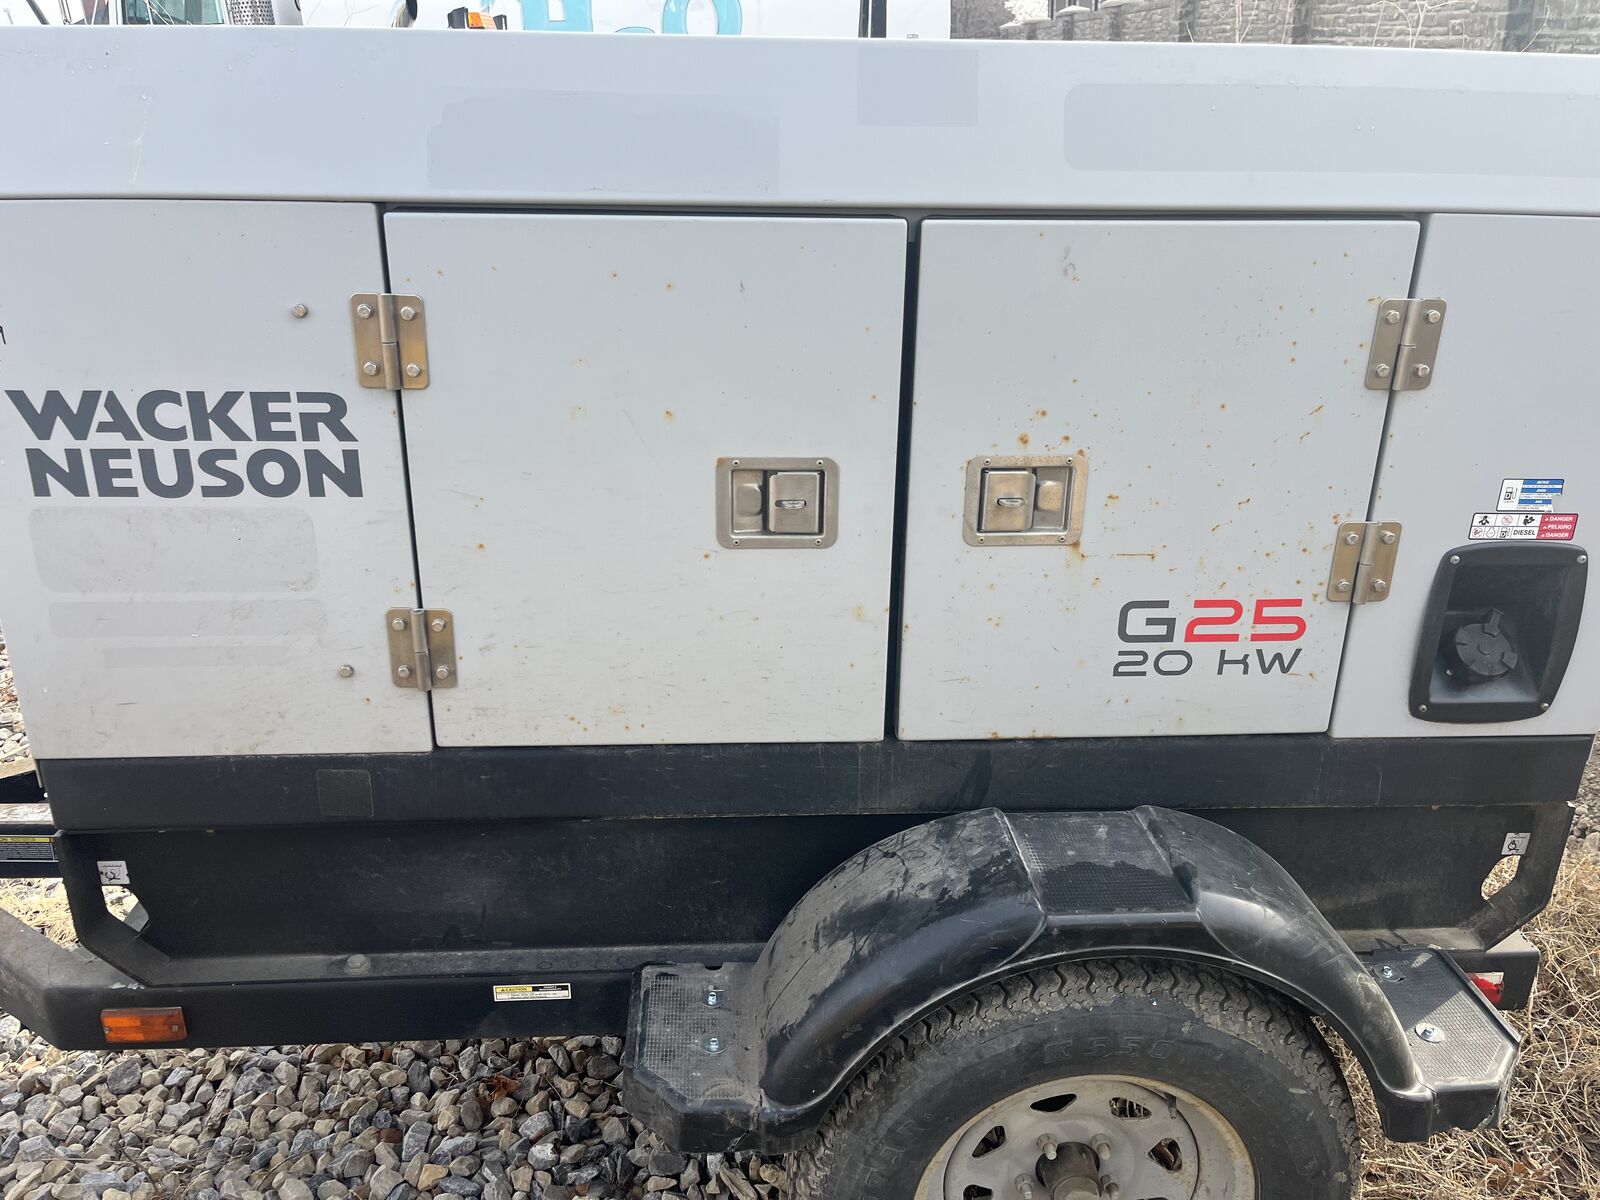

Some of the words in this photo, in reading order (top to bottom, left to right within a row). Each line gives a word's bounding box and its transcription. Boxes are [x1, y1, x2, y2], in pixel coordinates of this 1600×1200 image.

[4, 389, 359, 442] WACKER
[25, 448, 364, 499] NEUSON
[1117, 598, 1307, 643] G25
[1112, 649, 1193, 676] 20
